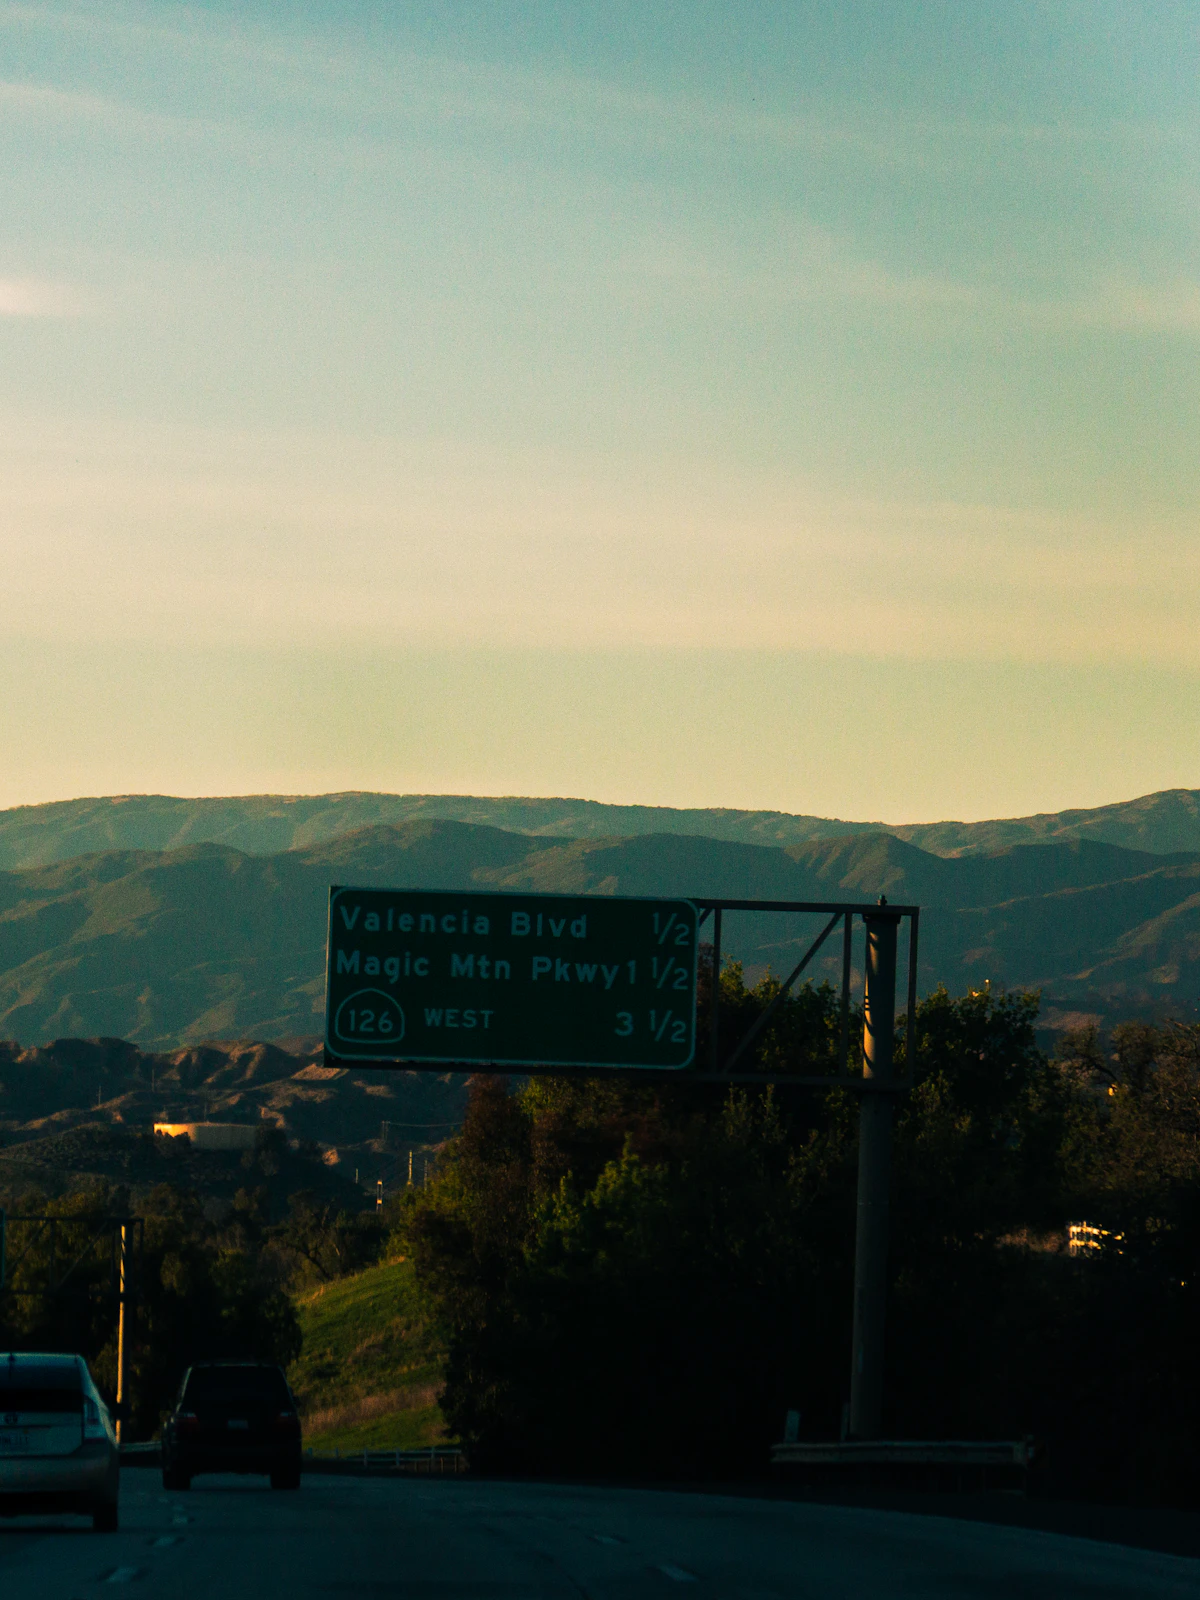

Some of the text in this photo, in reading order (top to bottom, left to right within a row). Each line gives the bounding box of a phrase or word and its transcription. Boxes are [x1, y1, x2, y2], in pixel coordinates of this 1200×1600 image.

[339, 905, 491, 936] Valencia
[510, 911, 588, 939] Blvd
[335, 948, 431, 985] Magic
[450, 952, 512, 981] Mtn
[531, 957, 620, 990] Pkwy
[625, 959, 637, 985] 1
[347, 1008, 395, 1034] 126
[423, 1007, 495, 1030] WEST
[613, 1011, 635, 1037] 3
